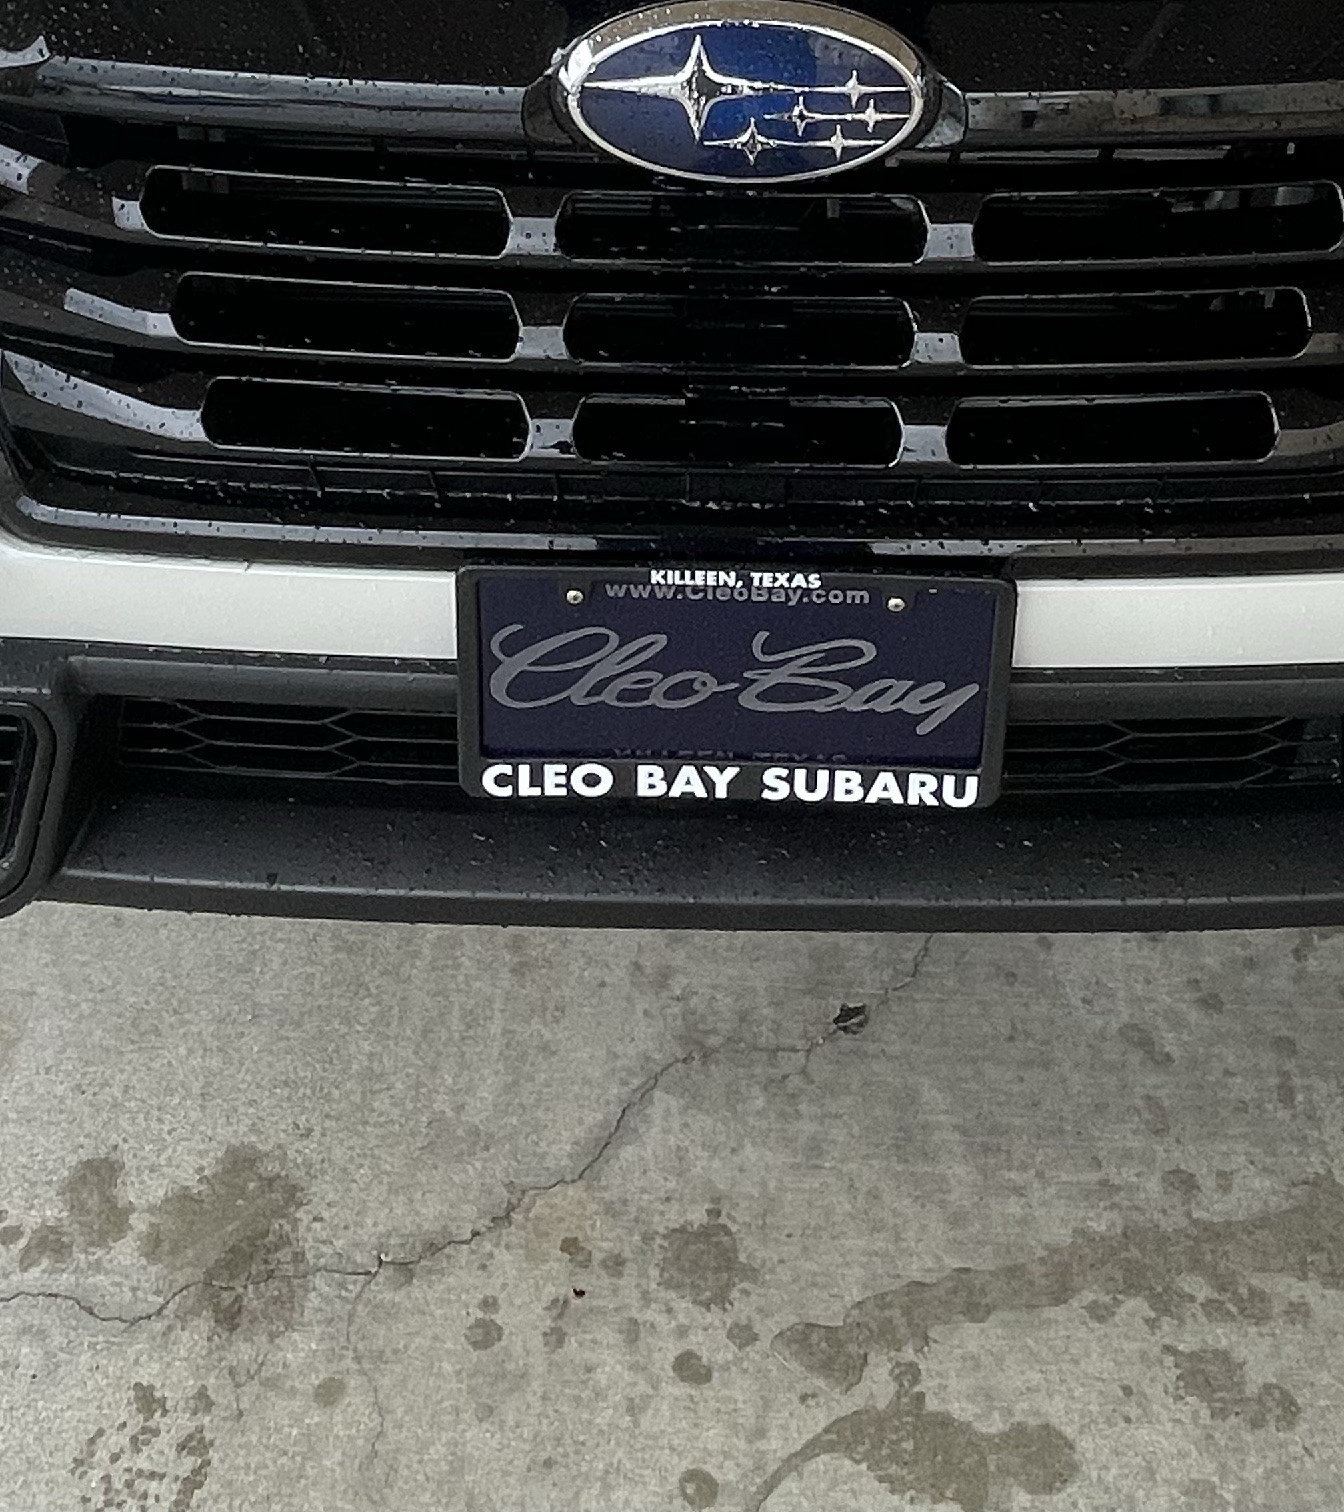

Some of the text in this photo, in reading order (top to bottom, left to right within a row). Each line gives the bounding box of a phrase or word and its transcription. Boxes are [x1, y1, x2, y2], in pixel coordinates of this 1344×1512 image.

[650, 570, 822, 589] KILLEEN, TEXAS
[490, 624, 980, 736] Cleo Bay
[482, 763, 979, 808] CLEO BAY SUBARU
